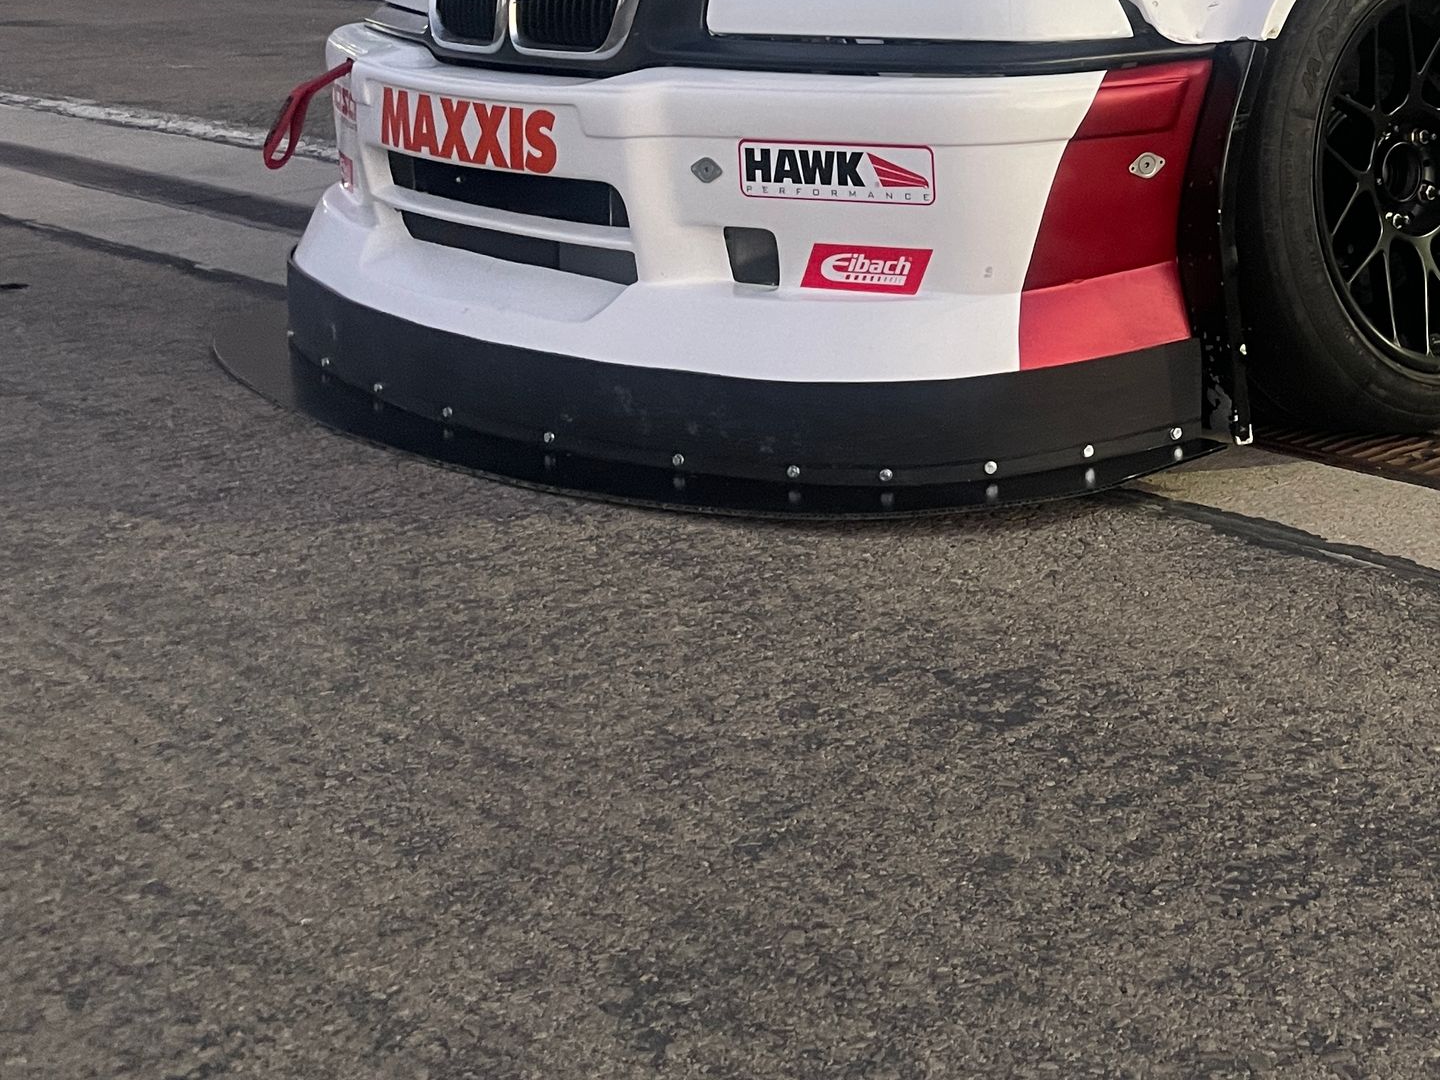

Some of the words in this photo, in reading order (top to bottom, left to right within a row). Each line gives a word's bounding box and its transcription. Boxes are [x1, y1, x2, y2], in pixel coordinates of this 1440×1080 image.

[381, 86, 558, 174] MAXXIS
[744, 147, 866, 187] HAWK
[746, 186, 930, 202] PERFORMANCE
[820, 253, 912, 286] Eibach
